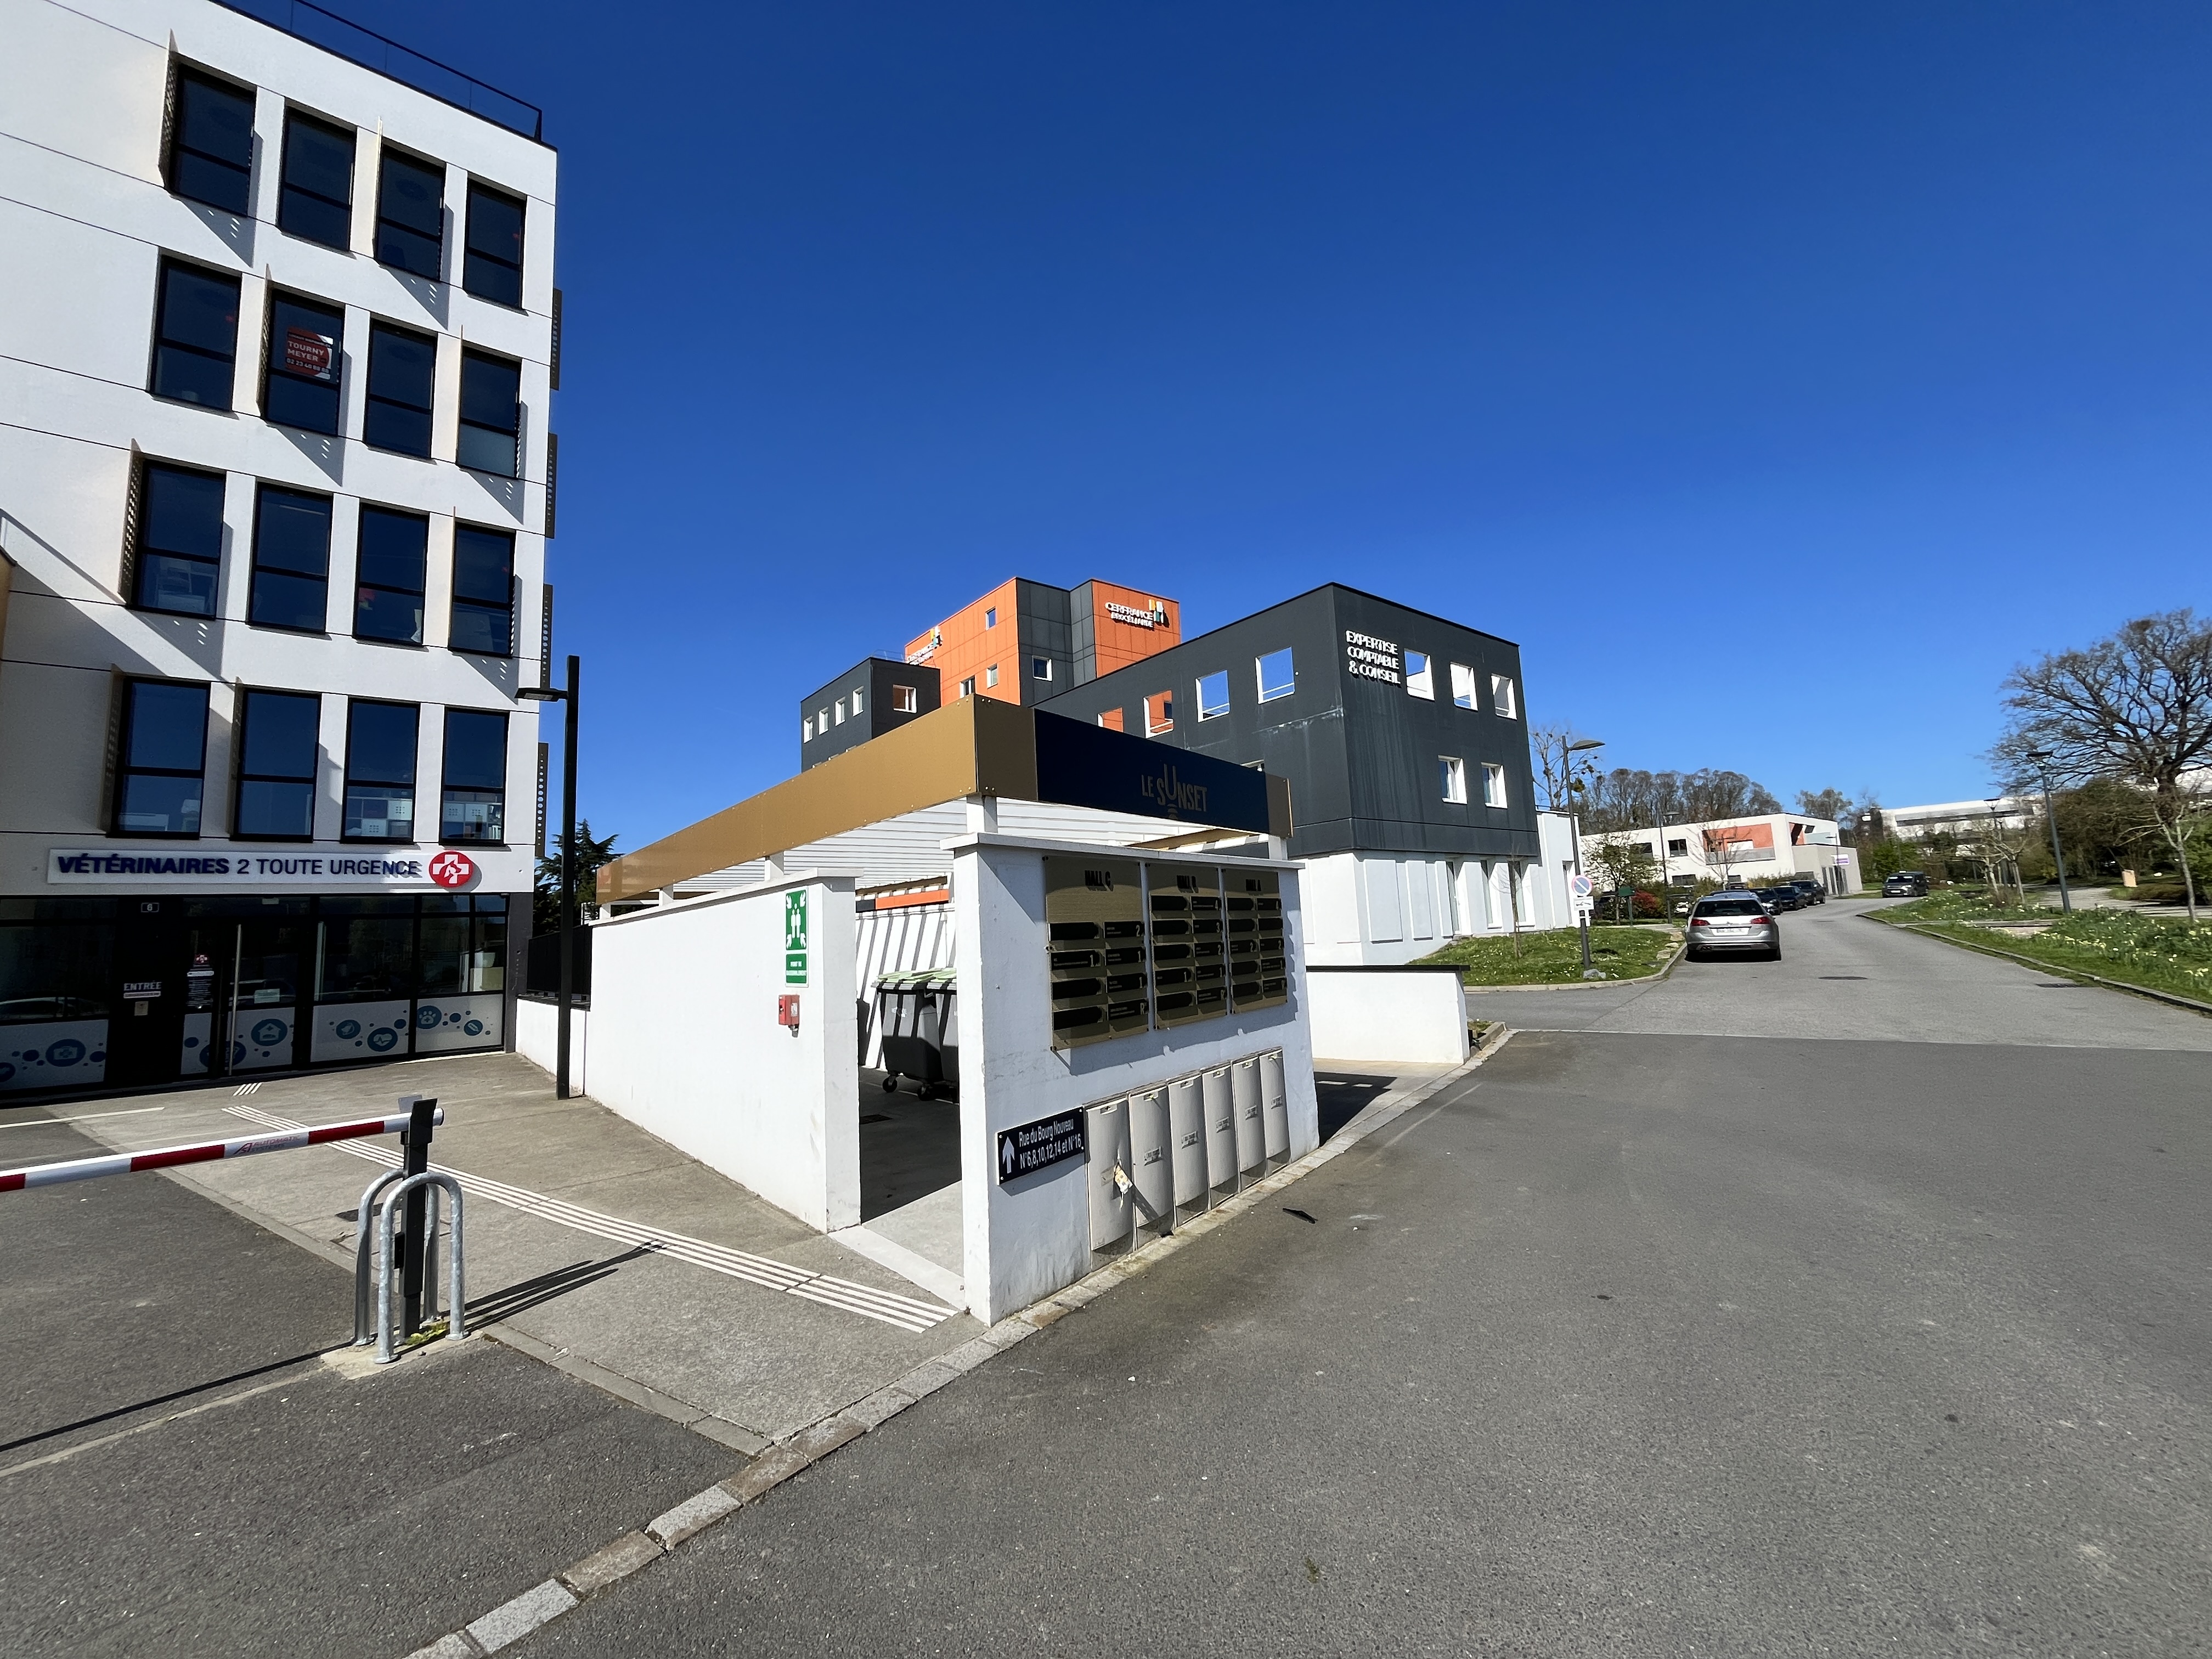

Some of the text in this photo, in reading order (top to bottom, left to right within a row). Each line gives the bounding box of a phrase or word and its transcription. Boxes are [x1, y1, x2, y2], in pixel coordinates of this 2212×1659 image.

[287, 349, 318, 362] MEYER
[288, 341, 324, 356] TOURNY
[1346, 630, 1398, 654] EXPERTISE
[1347, 646, 1400, 669] COMPTABLE
[1348, 660, 1401, 684] & CONSEIL
[1142, 763, 1207, 812] LE SUNSET
[58, 853, 419, 876] VÉTÉRINAIRES 2 TOUTE URGENCE
[1085, 870, 1111, 887] HALL C
[1136, 925, 1141, 937] 2
[1090, 955, 1094, 967] 1
[123, 980, 162, 991] ENTRÉE
[1019, 1119, 1074, 1147] Rue du Bourg Nouveau
[1062, 1139, 1068, 1153] et
[1068, 1133, 1081, 1151] N°16
